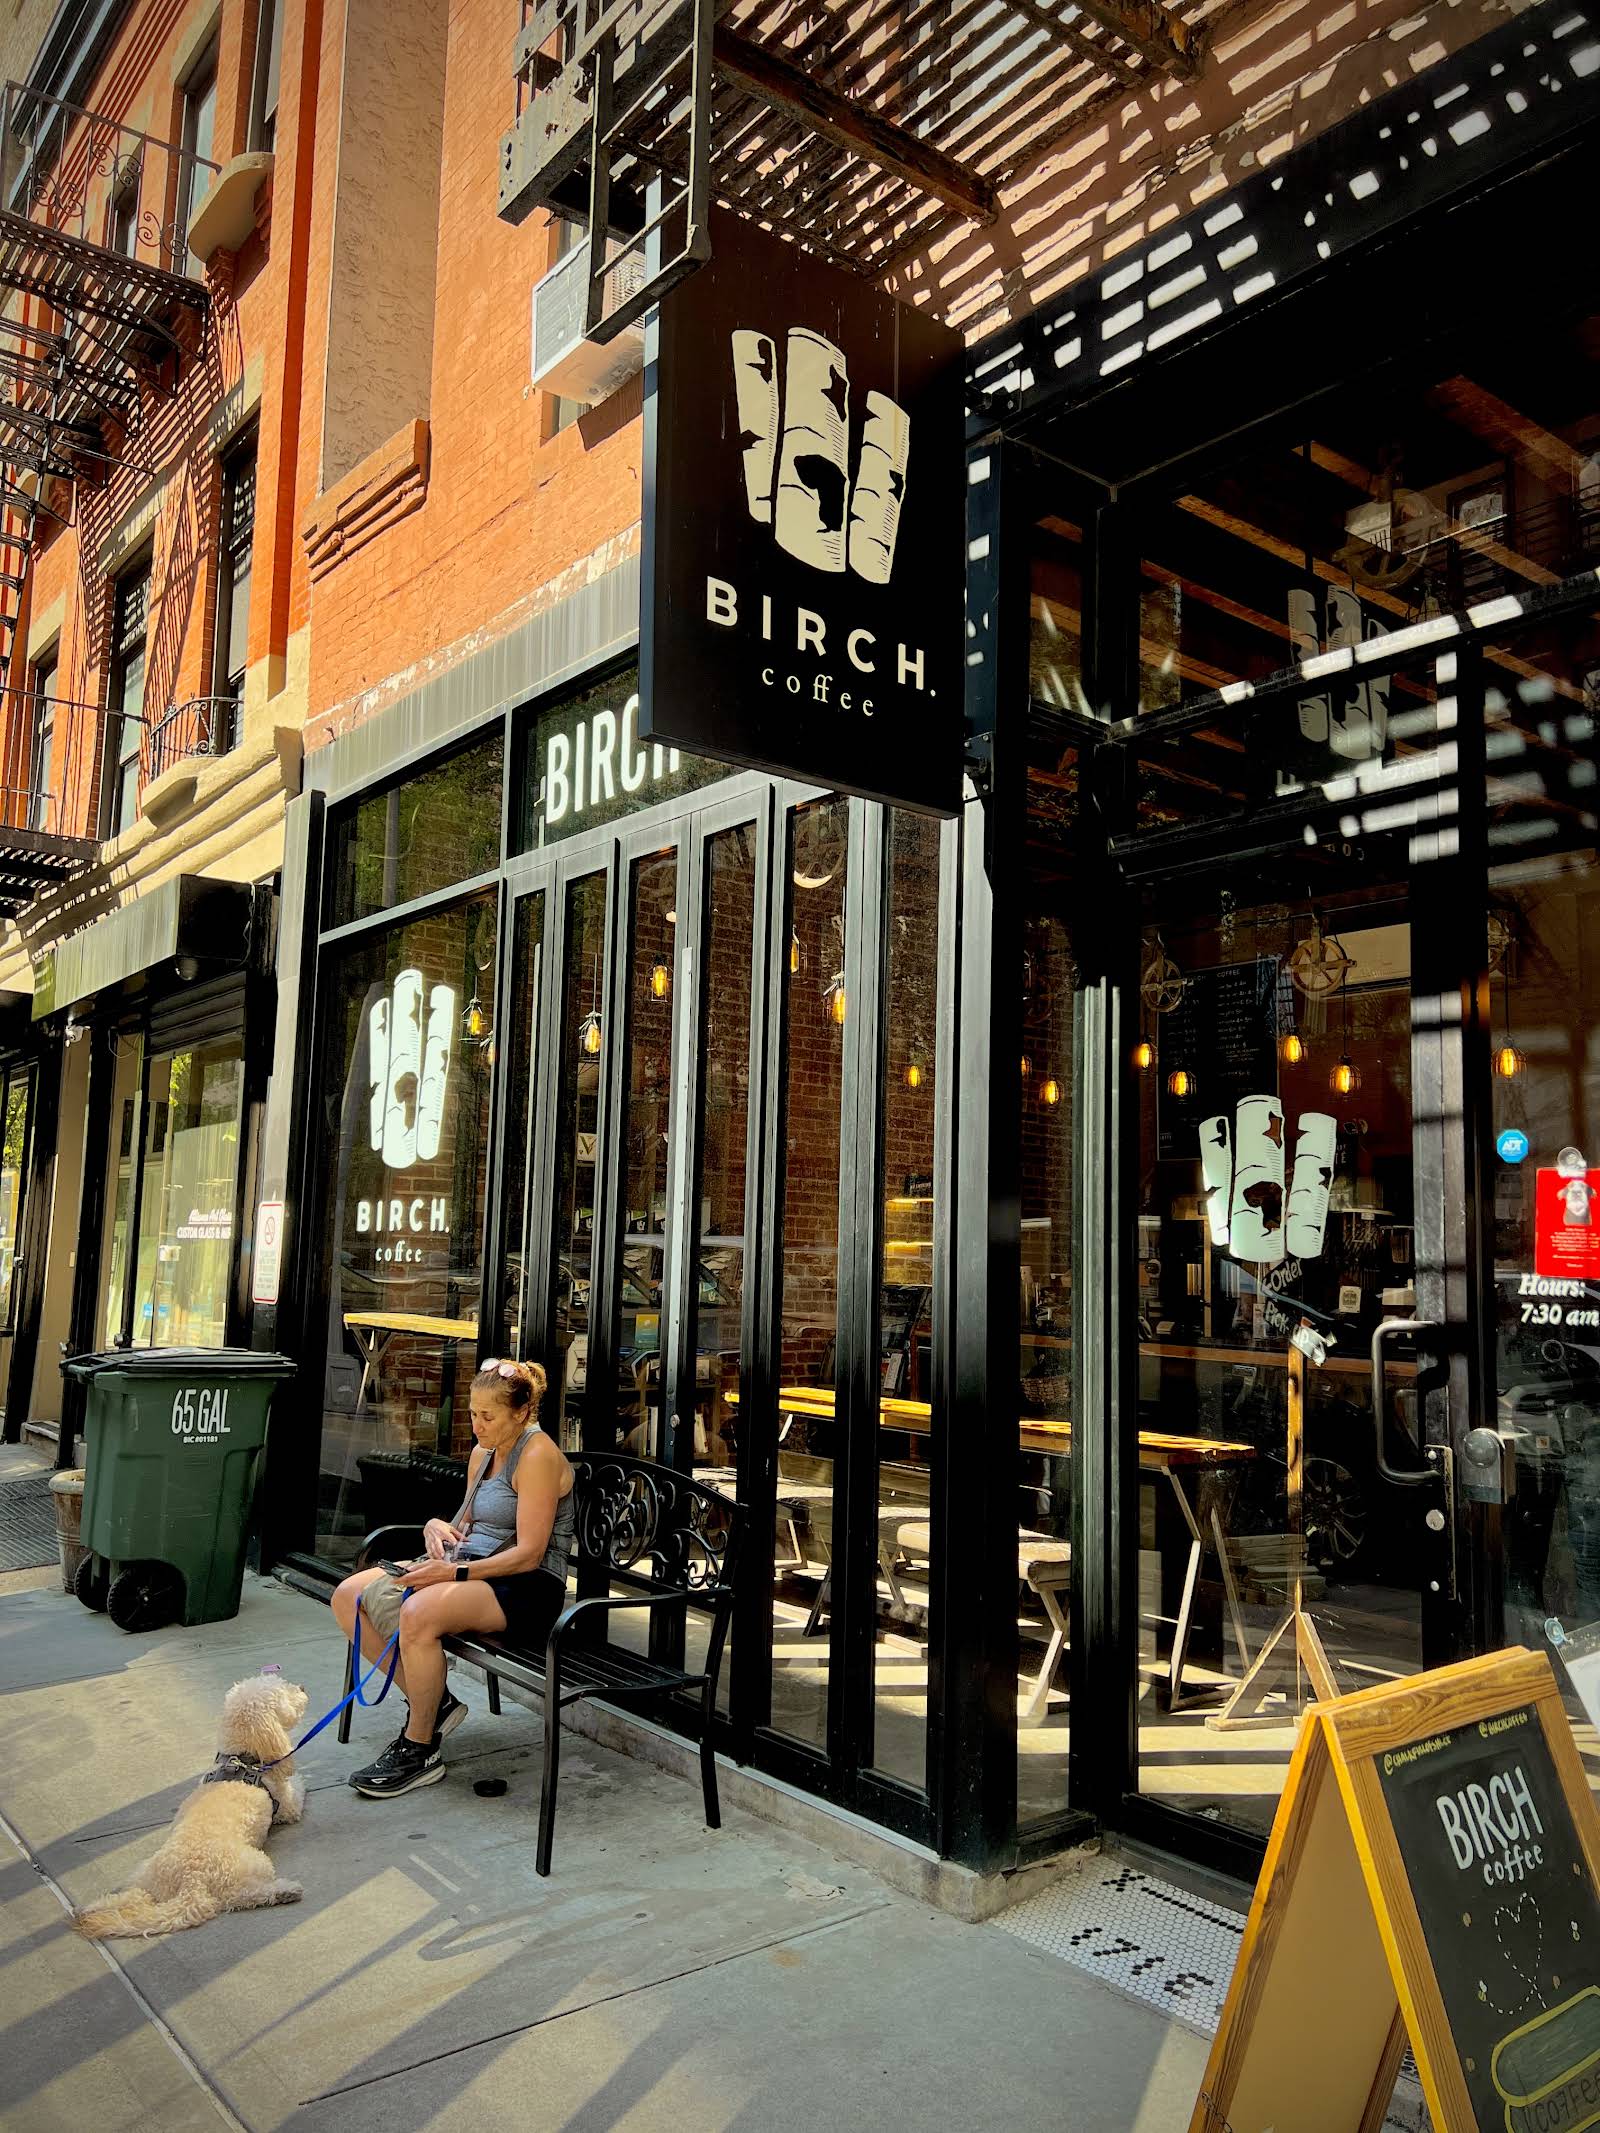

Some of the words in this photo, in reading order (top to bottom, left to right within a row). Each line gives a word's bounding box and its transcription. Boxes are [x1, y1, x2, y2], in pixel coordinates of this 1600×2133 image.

[706, 576, 937, 697] BIRCH.
[762, 667, 874, 716] coffee
[356, 1198, 450, 1233] BIRCH.
[375, 1240, 422, 1262] coffee
[1517, 1272, 1586, 1298] Hours:
[1521, 1302, 1562, 1325] 7:30
[1565, 1309, 1600, 1328] am
[171, 1388, 197, 1434] 65
[197, 1388, 231, 1434] GAL
[1436, 1766, 1544, 1870] BIRCH
[1483, 1844, 1544, 1886] coffee
